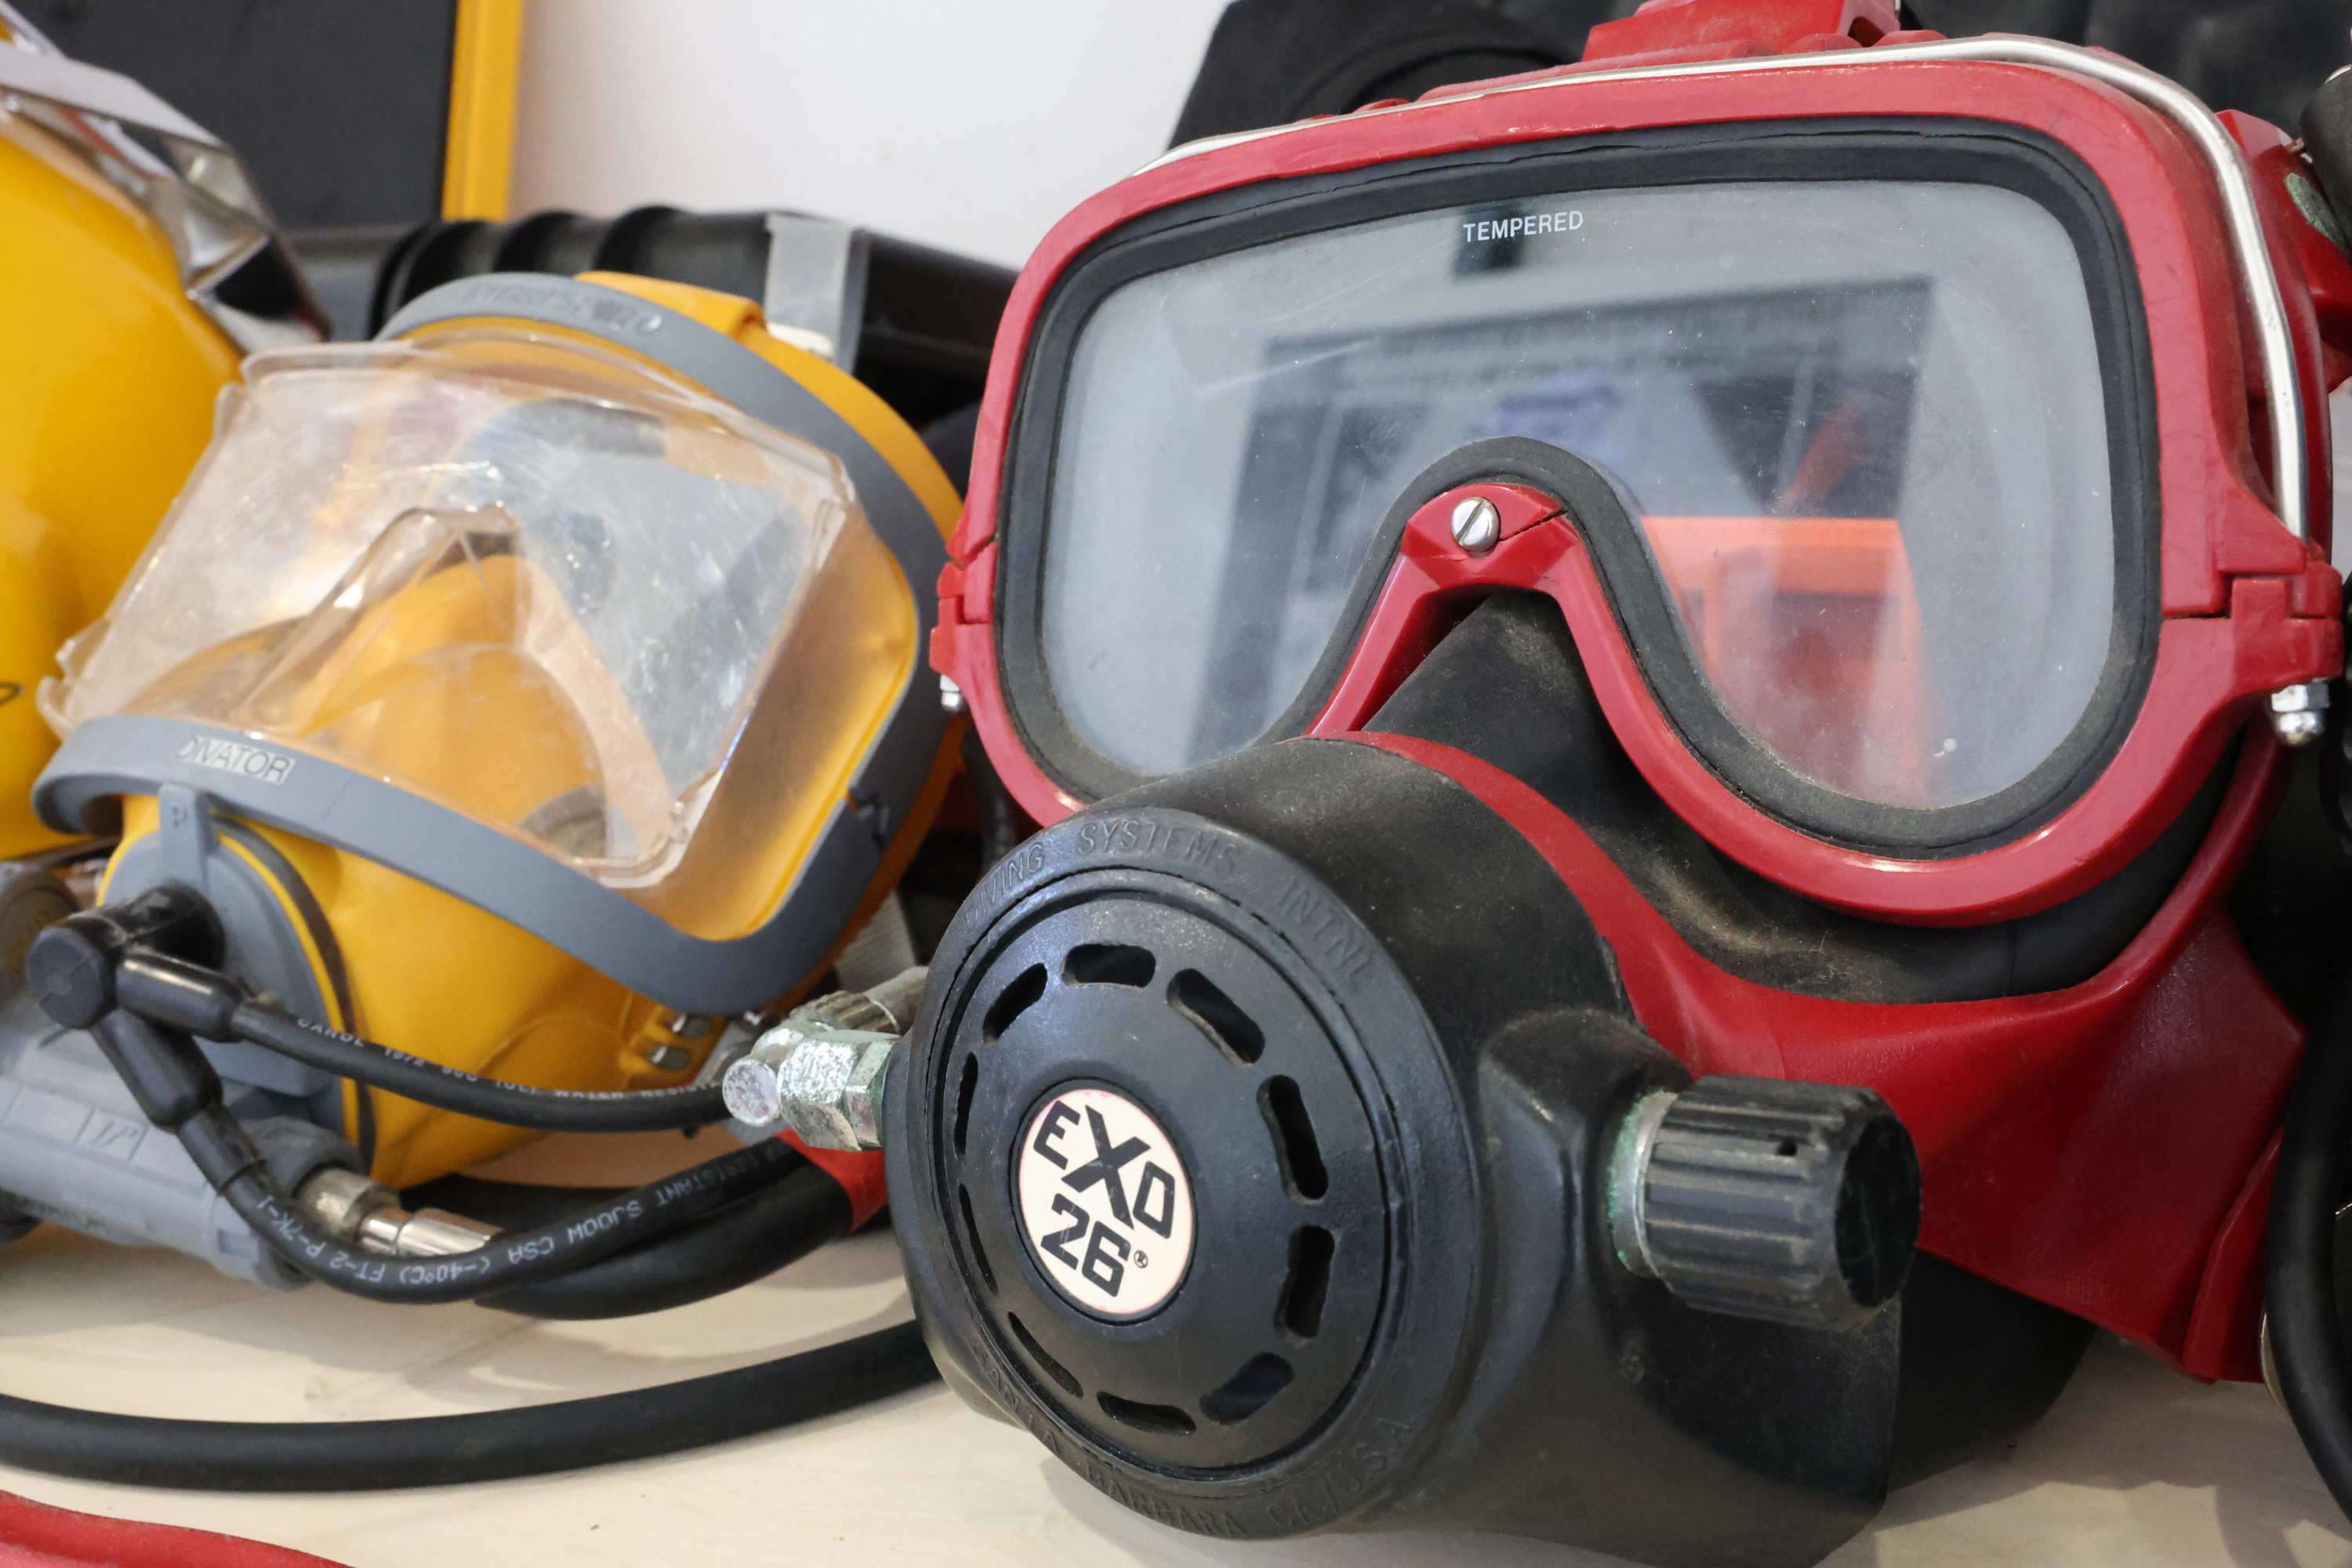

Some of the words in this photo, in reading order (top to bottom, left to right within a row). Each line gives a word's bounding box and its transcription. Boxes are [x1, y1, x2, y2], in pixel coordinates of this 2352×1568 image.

[1463, 210, 1584, 242] TEMPERED
[965, 842, 1044, 927] DIVING
[1076, 820, 1240, 872] SYSTEMS
[566, 1200, 644, 1244] SJOOW
[329, 1250, 387, 1283] FT-2
[508, 1236, 555, 1265] CSA
